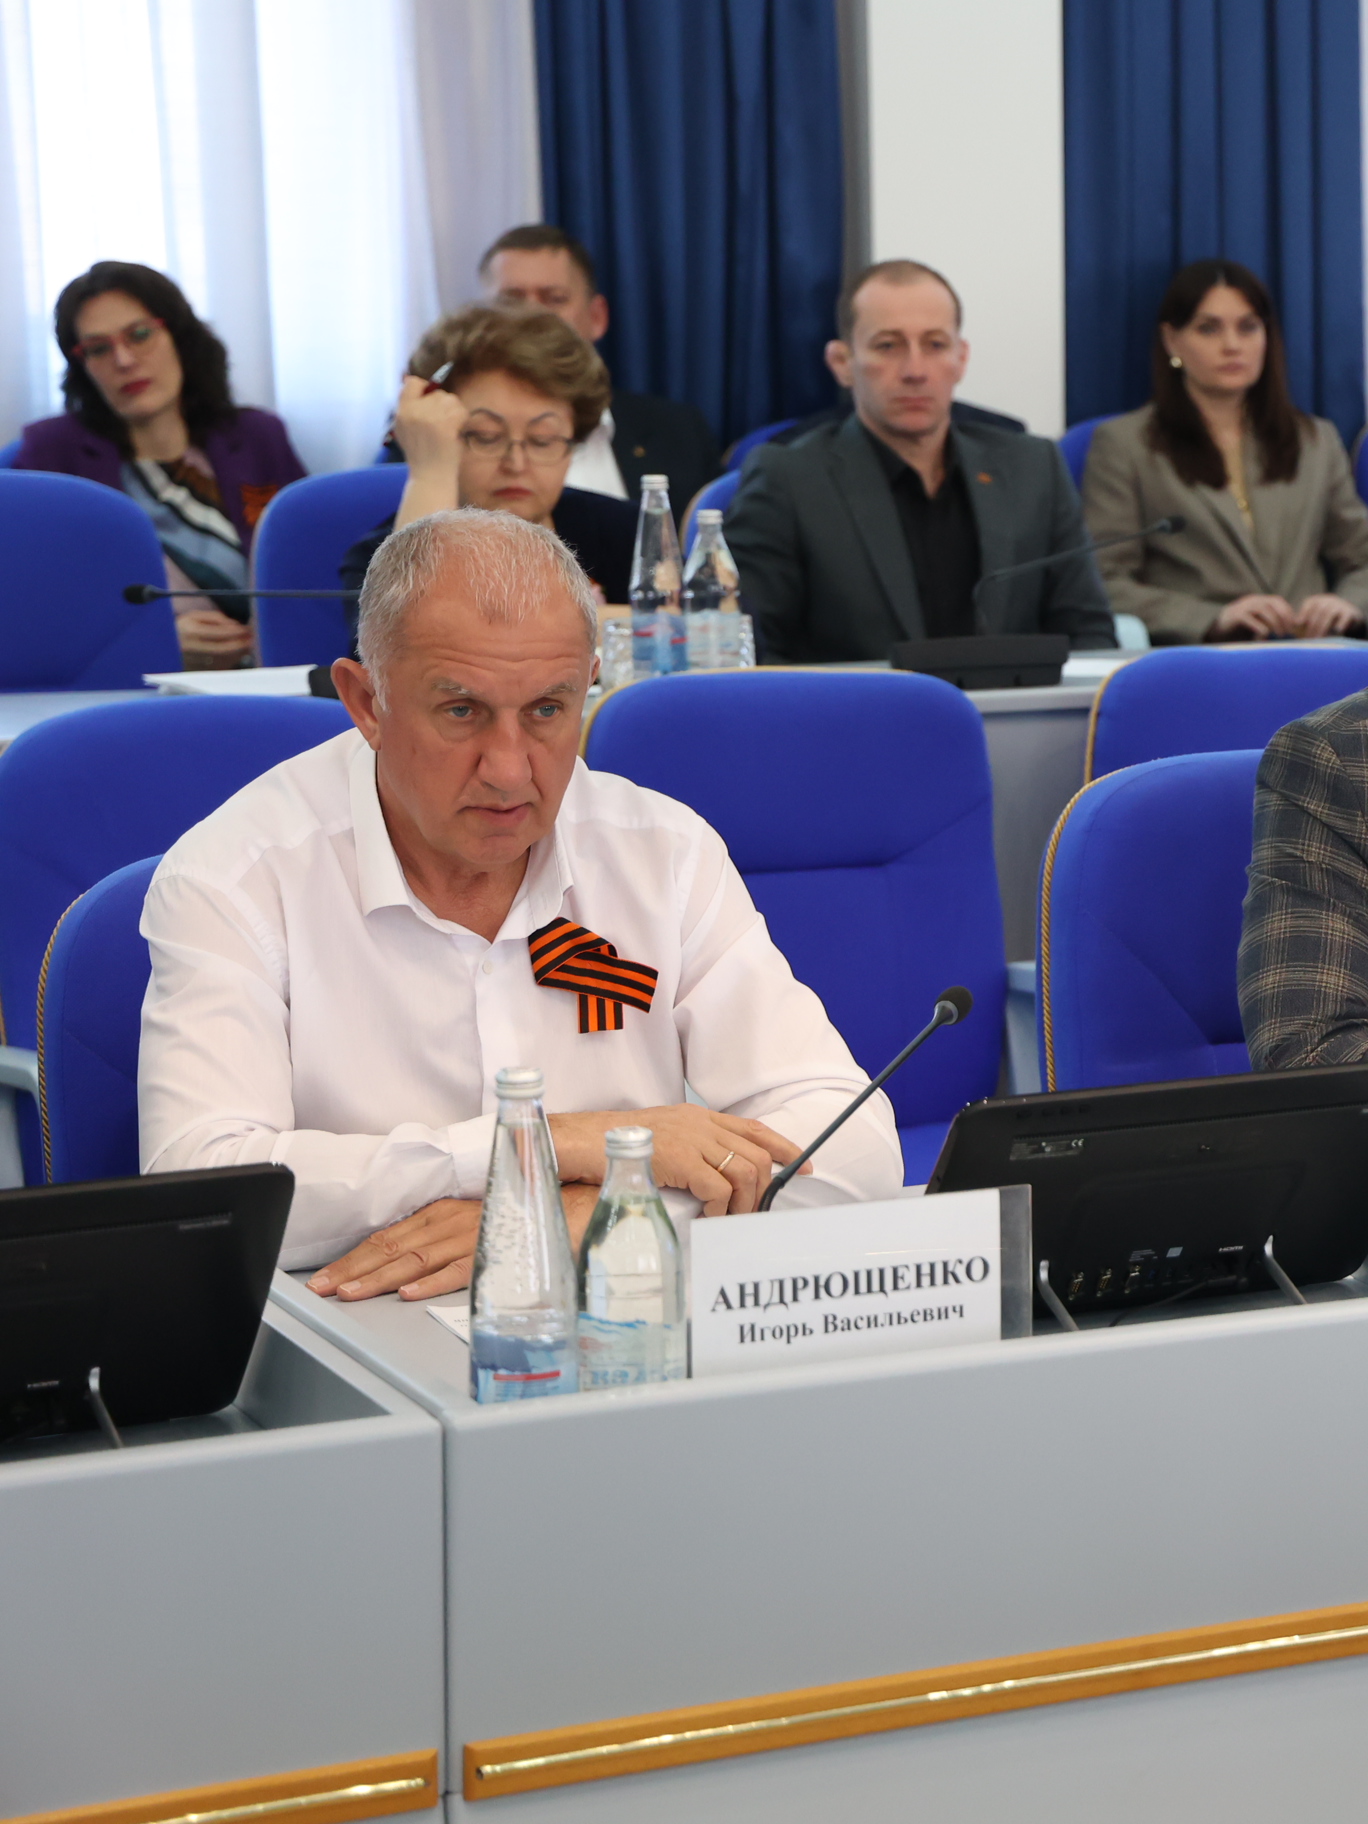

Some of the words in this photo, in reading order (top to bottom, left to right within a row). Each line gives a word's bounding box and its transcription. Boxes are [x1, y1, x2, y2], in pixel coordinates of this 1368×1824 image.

[709, 1255, 991, 1313] АНДРЮЩЕНКО
[737, 1322, 815, 1345] Игорь
[822, 1303, 965, 1335] Васильевич
